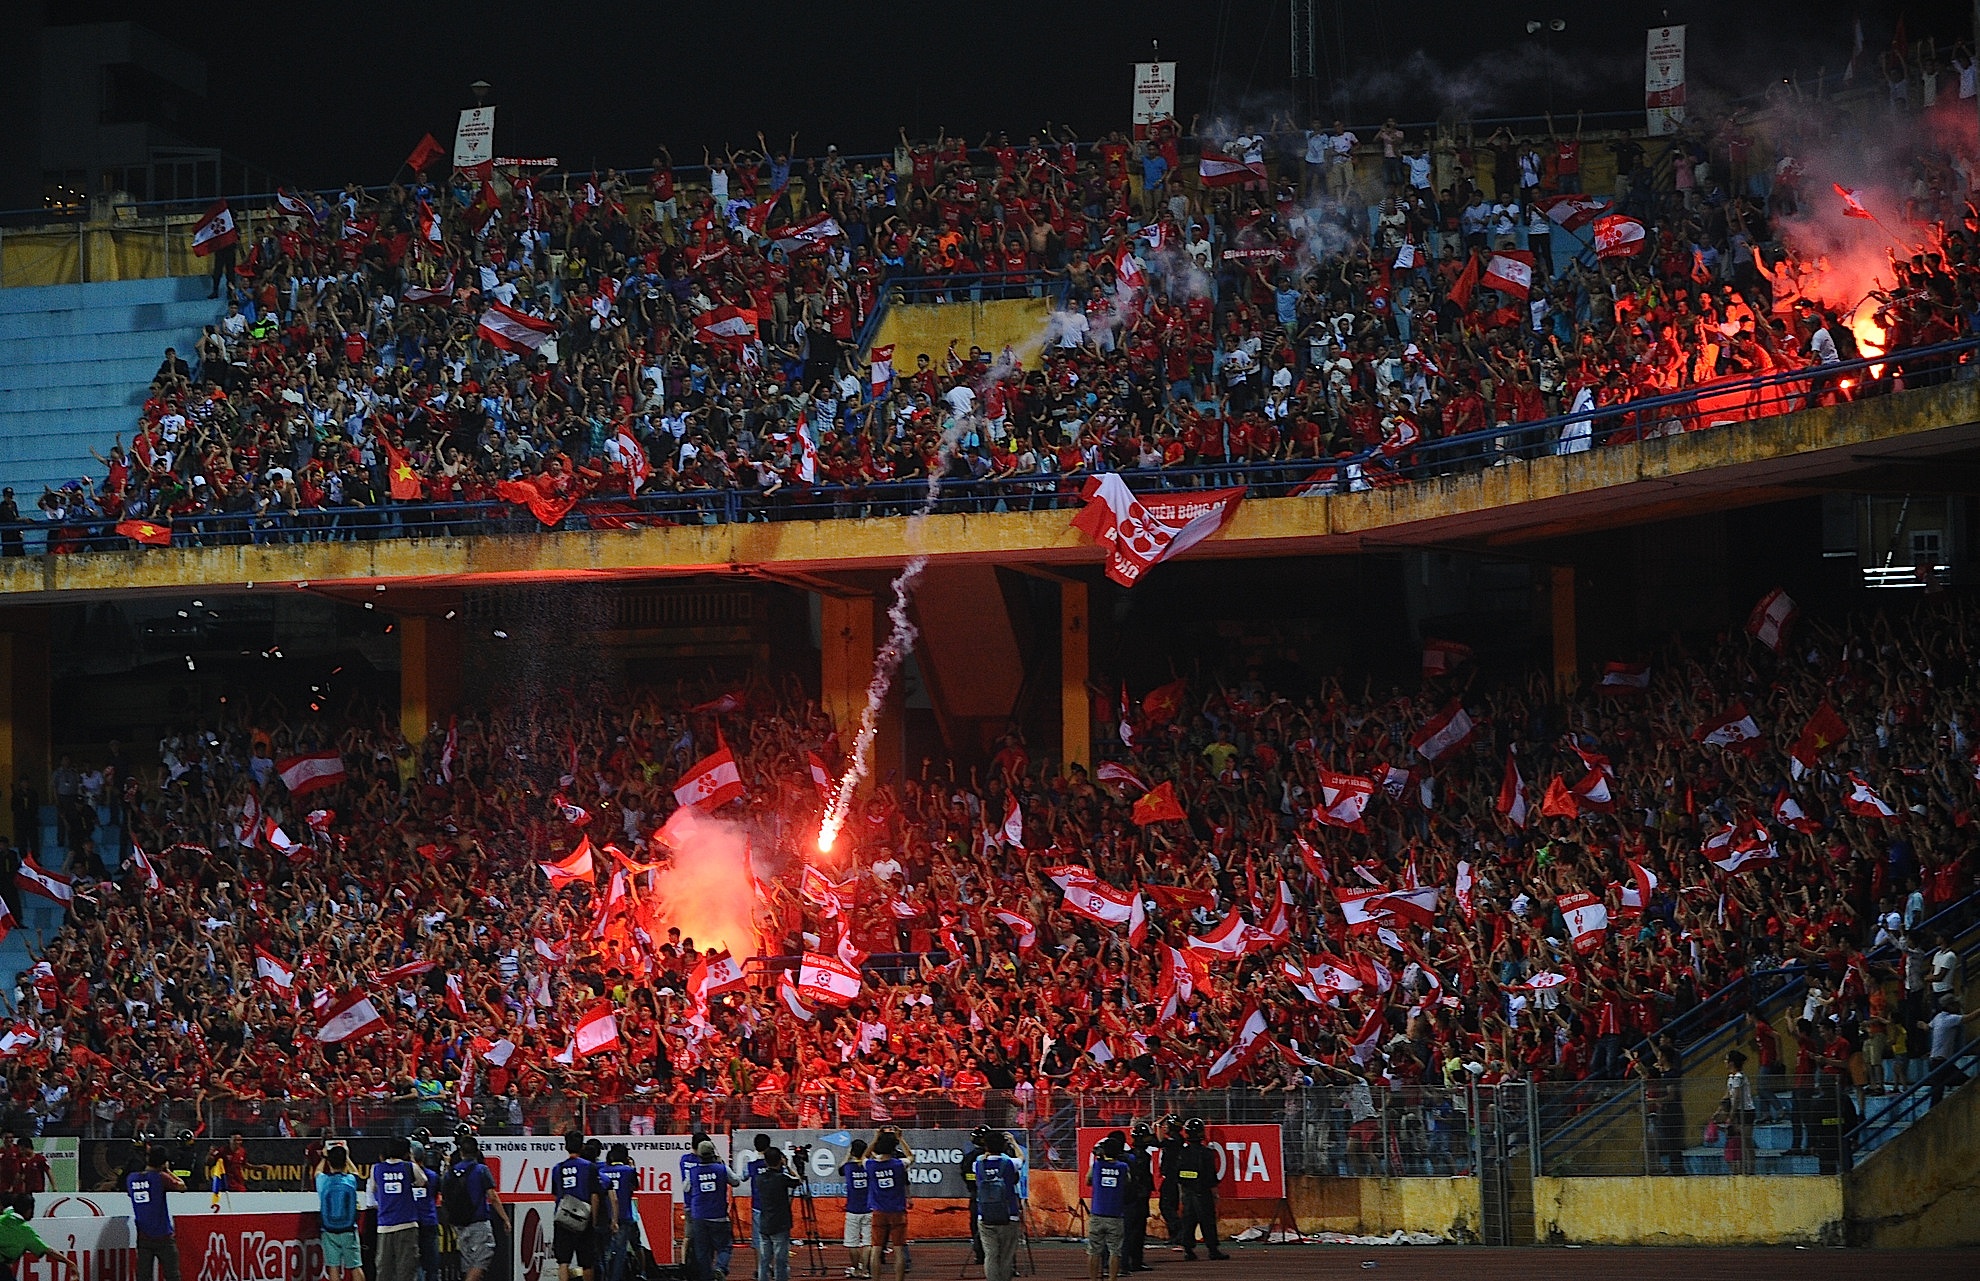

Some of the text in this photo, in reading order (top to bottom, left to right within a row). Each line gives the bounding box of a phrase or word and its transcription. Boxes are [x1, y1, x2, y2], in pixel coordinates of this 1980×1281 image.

[495, 1141, 527, 1152] THÔNG
[1145, 1142, 1270, 1182] OTA
[266, 1164, 314, 1181] MIN
[383, 1172, 404, 1180] 2016
[562, 1166, 577, 1175] 016
[905, 1168, 943, 1184] HAO
[240, 1231, 346, 1281] Kapp
